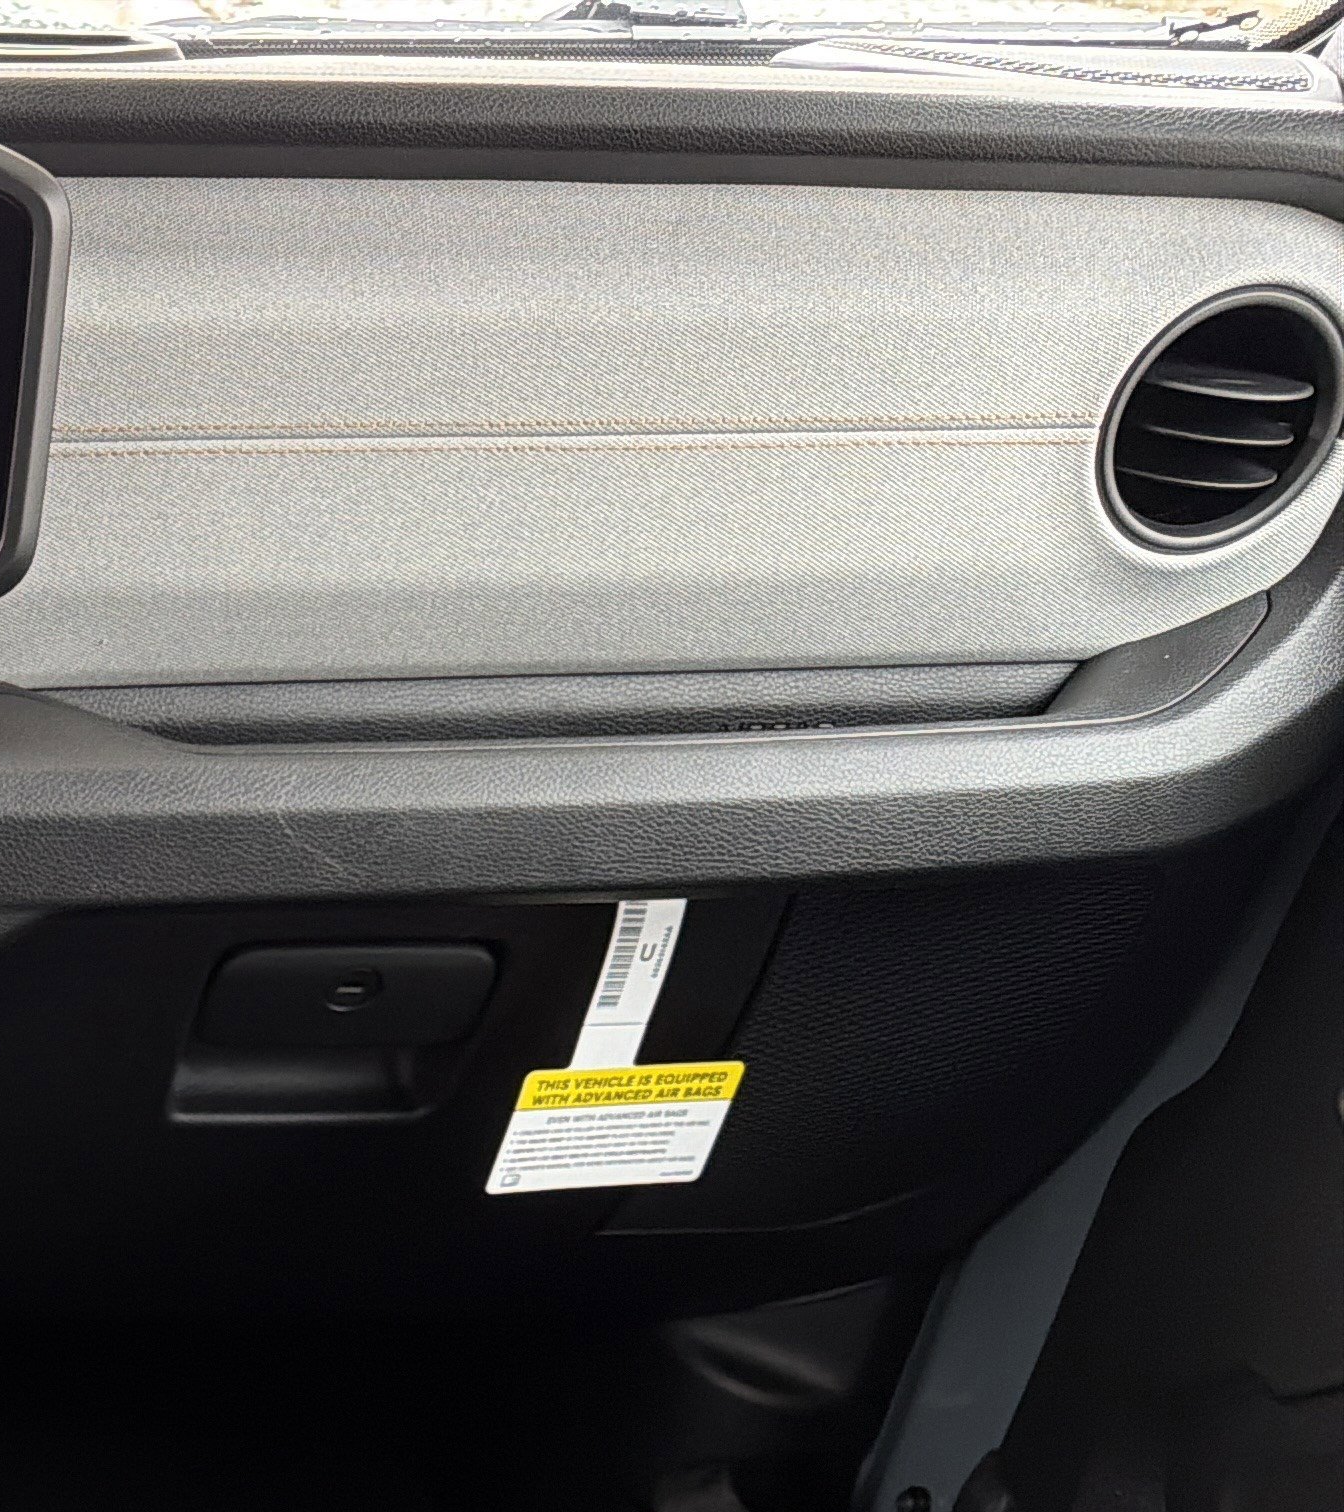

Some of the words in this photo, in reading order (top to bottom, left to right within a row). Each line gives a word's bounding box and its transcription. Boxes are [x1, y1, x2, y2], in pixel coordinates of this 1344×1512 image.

[536, 1079, 571, 1092] THIS
[574, 1076, 633, 1090] VEHICLE
[637, 1075, 652, 1086] IS
[655, 1071, 729, 1085] EQUIPPED
[531, 1093, 570, 1106] WITH
[571, 1089, 652, 1104] ADVANCED
[655, 1087, 679, 1099] AIR
[681, 1085, 723, 1097] BAGS
